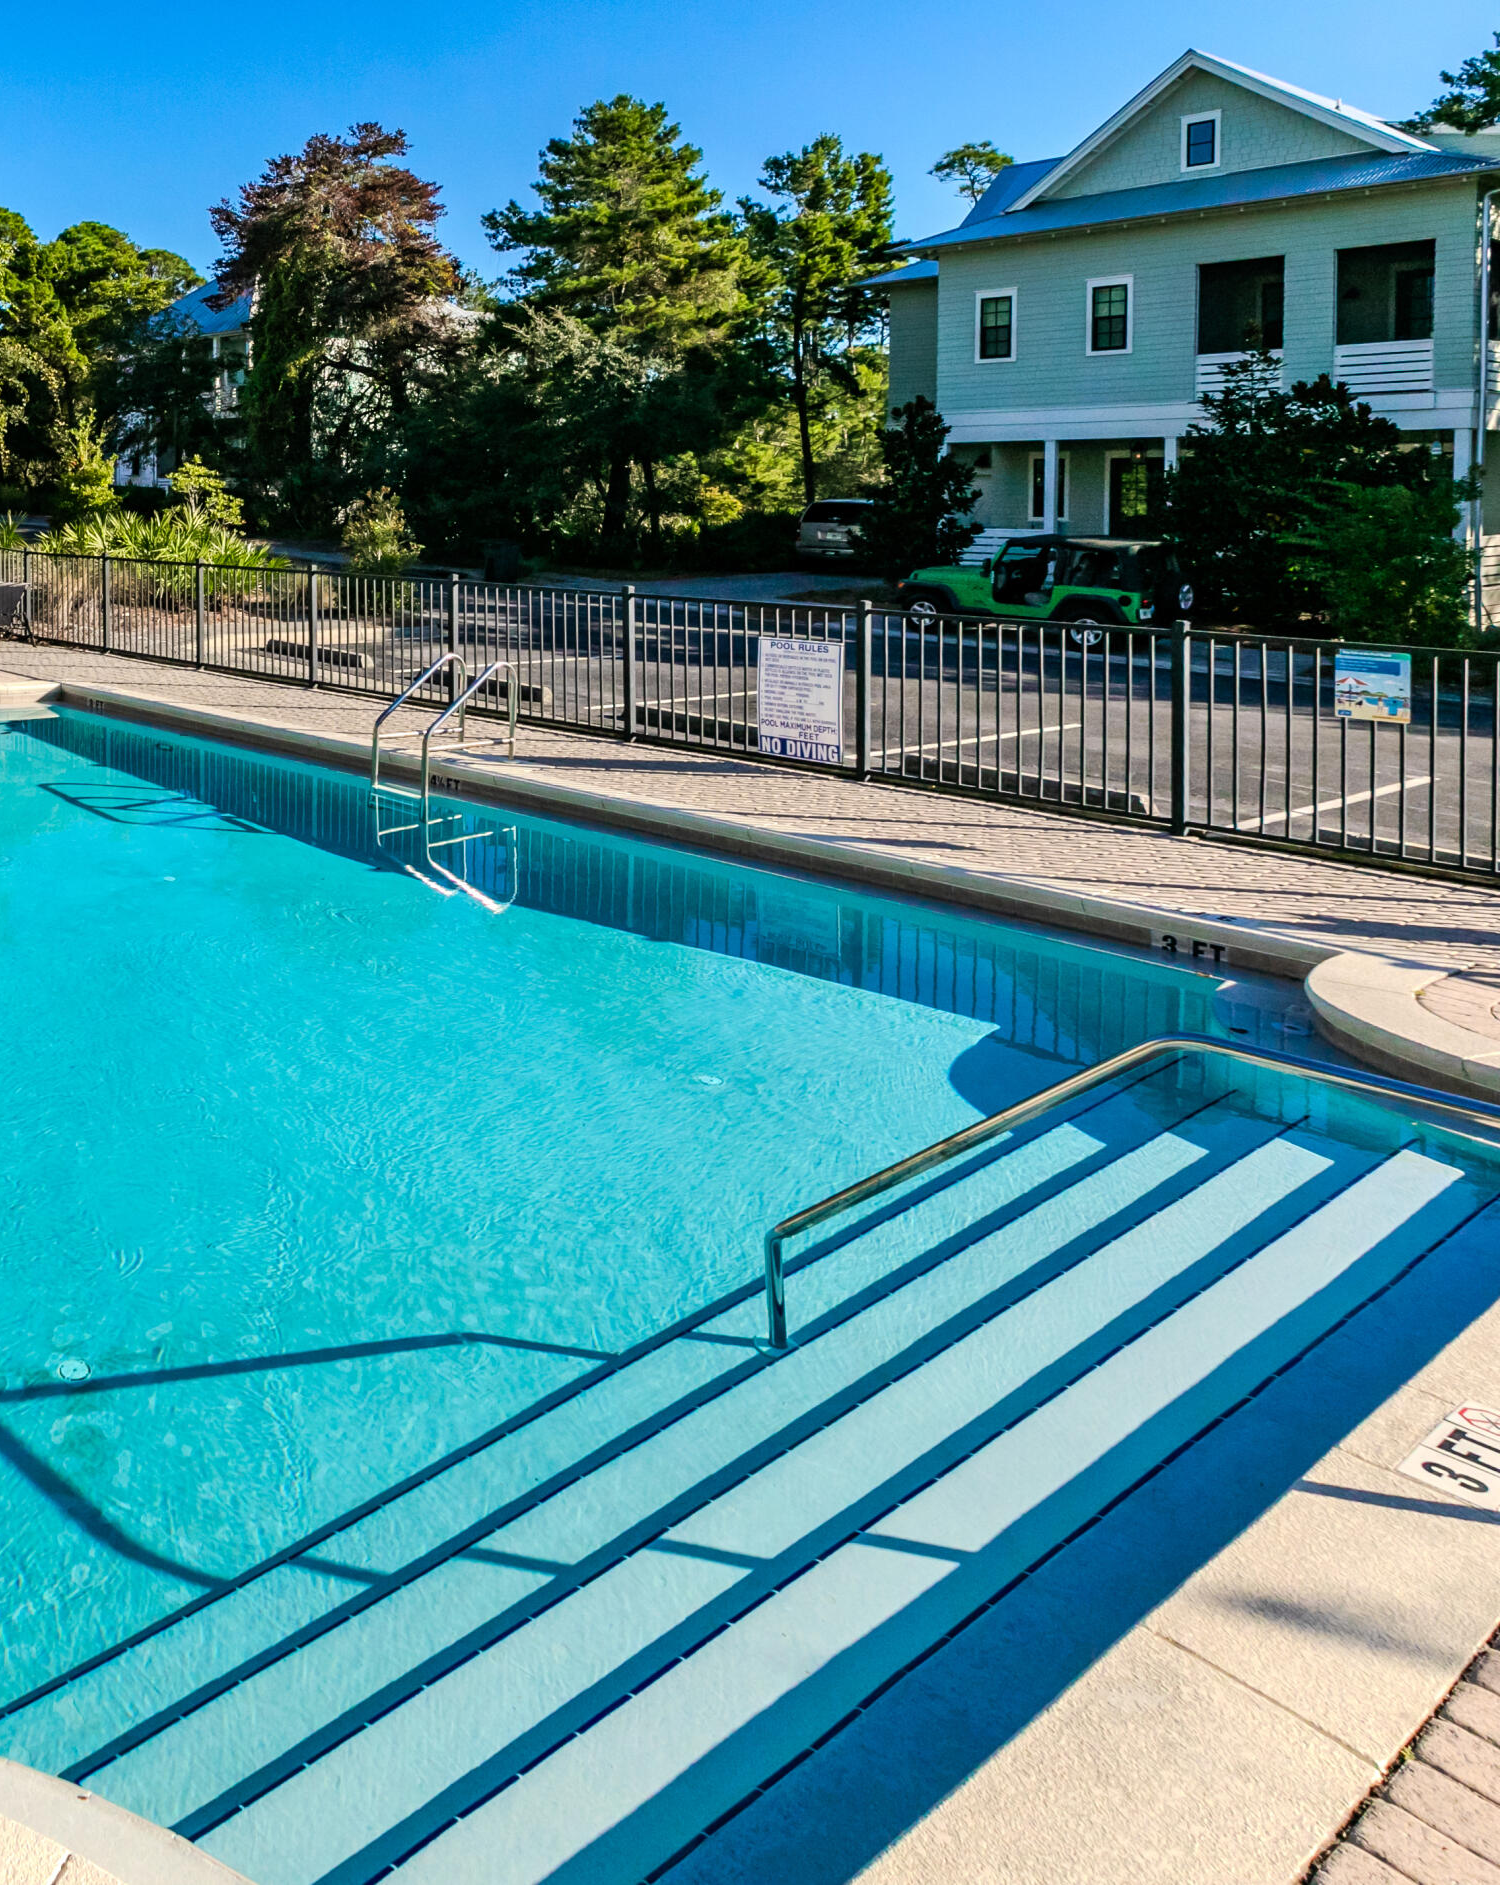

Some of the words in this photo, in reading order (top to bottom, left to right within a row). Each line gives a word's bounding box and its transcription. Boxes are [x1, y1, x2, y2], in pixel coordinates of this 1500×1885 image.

[770, 641, 796, 651] POOL
[798, 643, 829, 654] RULES
[761, 718, 779, 728] POOL
[780, 720, 812, 732] MAXIMUM
[798, 731, 820, 741] FEET
[761, 735, 781, 755] NO
[786, 739, 839, 763] DIVING
[446, 777, 460, 790] FT
[1161, 934, 1178, 953] 3
[1192, 940, 1226, 962] FT
[1421, 1461, 1489, 1493] 3
